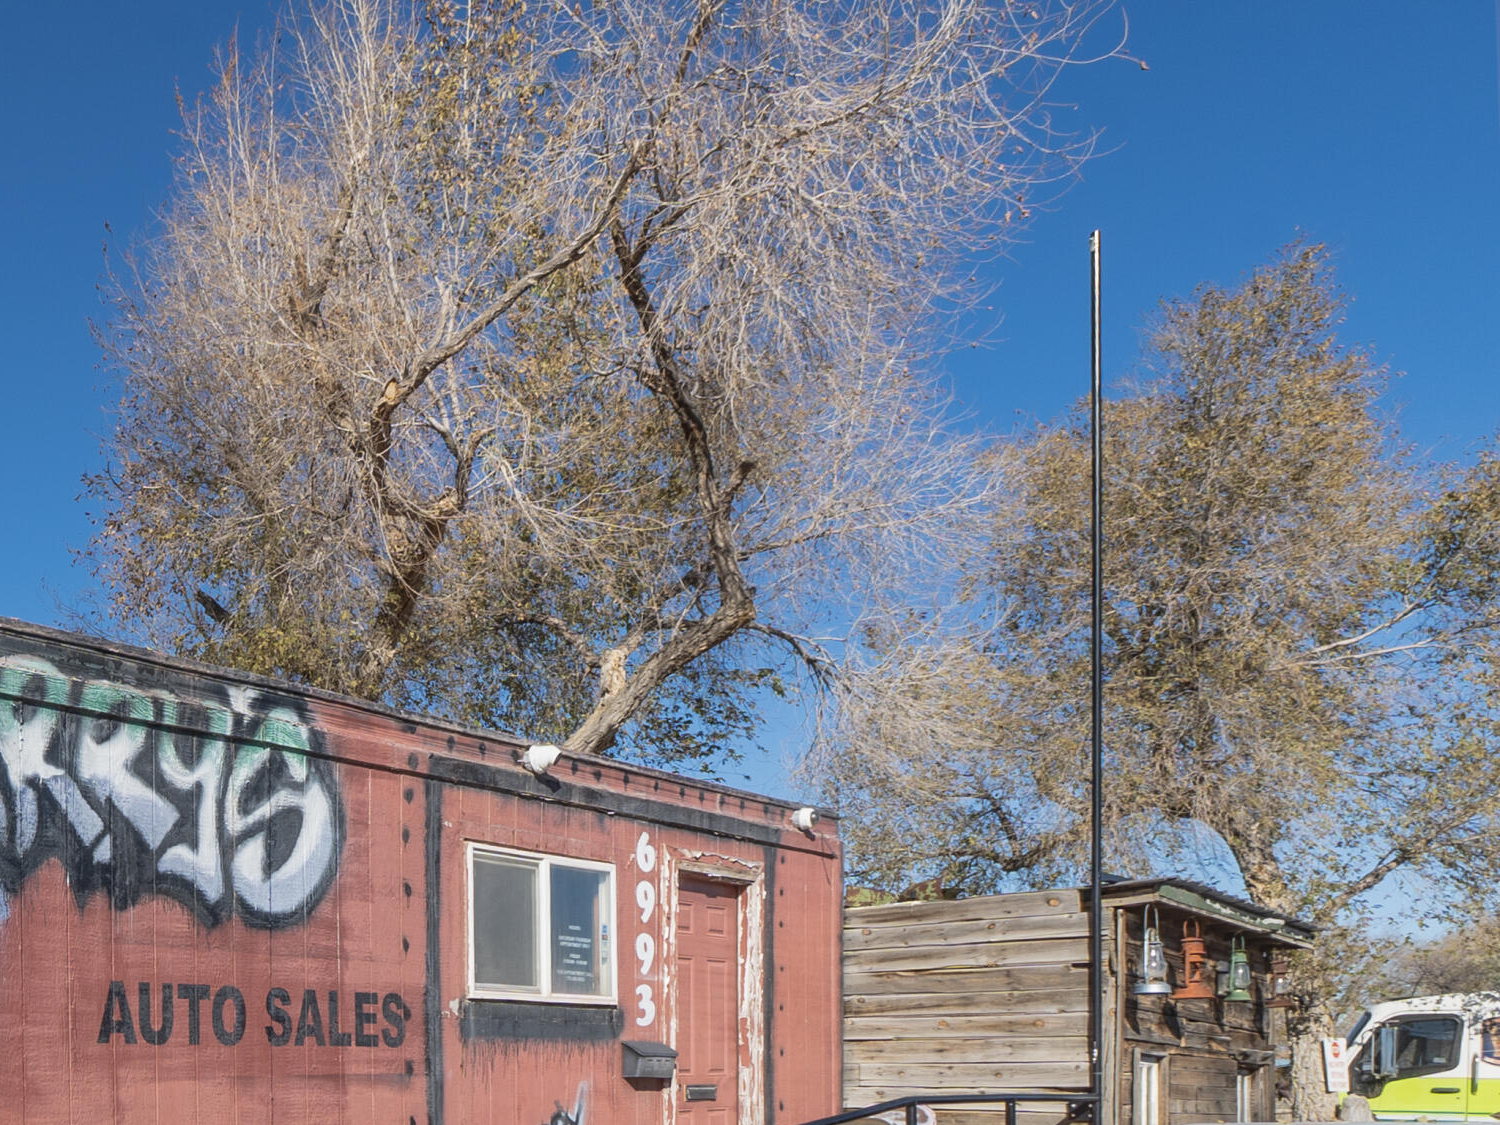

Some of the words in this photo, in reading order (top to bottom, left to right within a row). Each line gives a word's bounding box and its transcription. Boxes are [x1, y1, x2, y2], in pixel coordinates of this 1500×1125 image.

[636, 831, 656, 1026] 6993
[97, 980, 246, 1046] AUTO
[264, 987, 411, 1048] SALES
